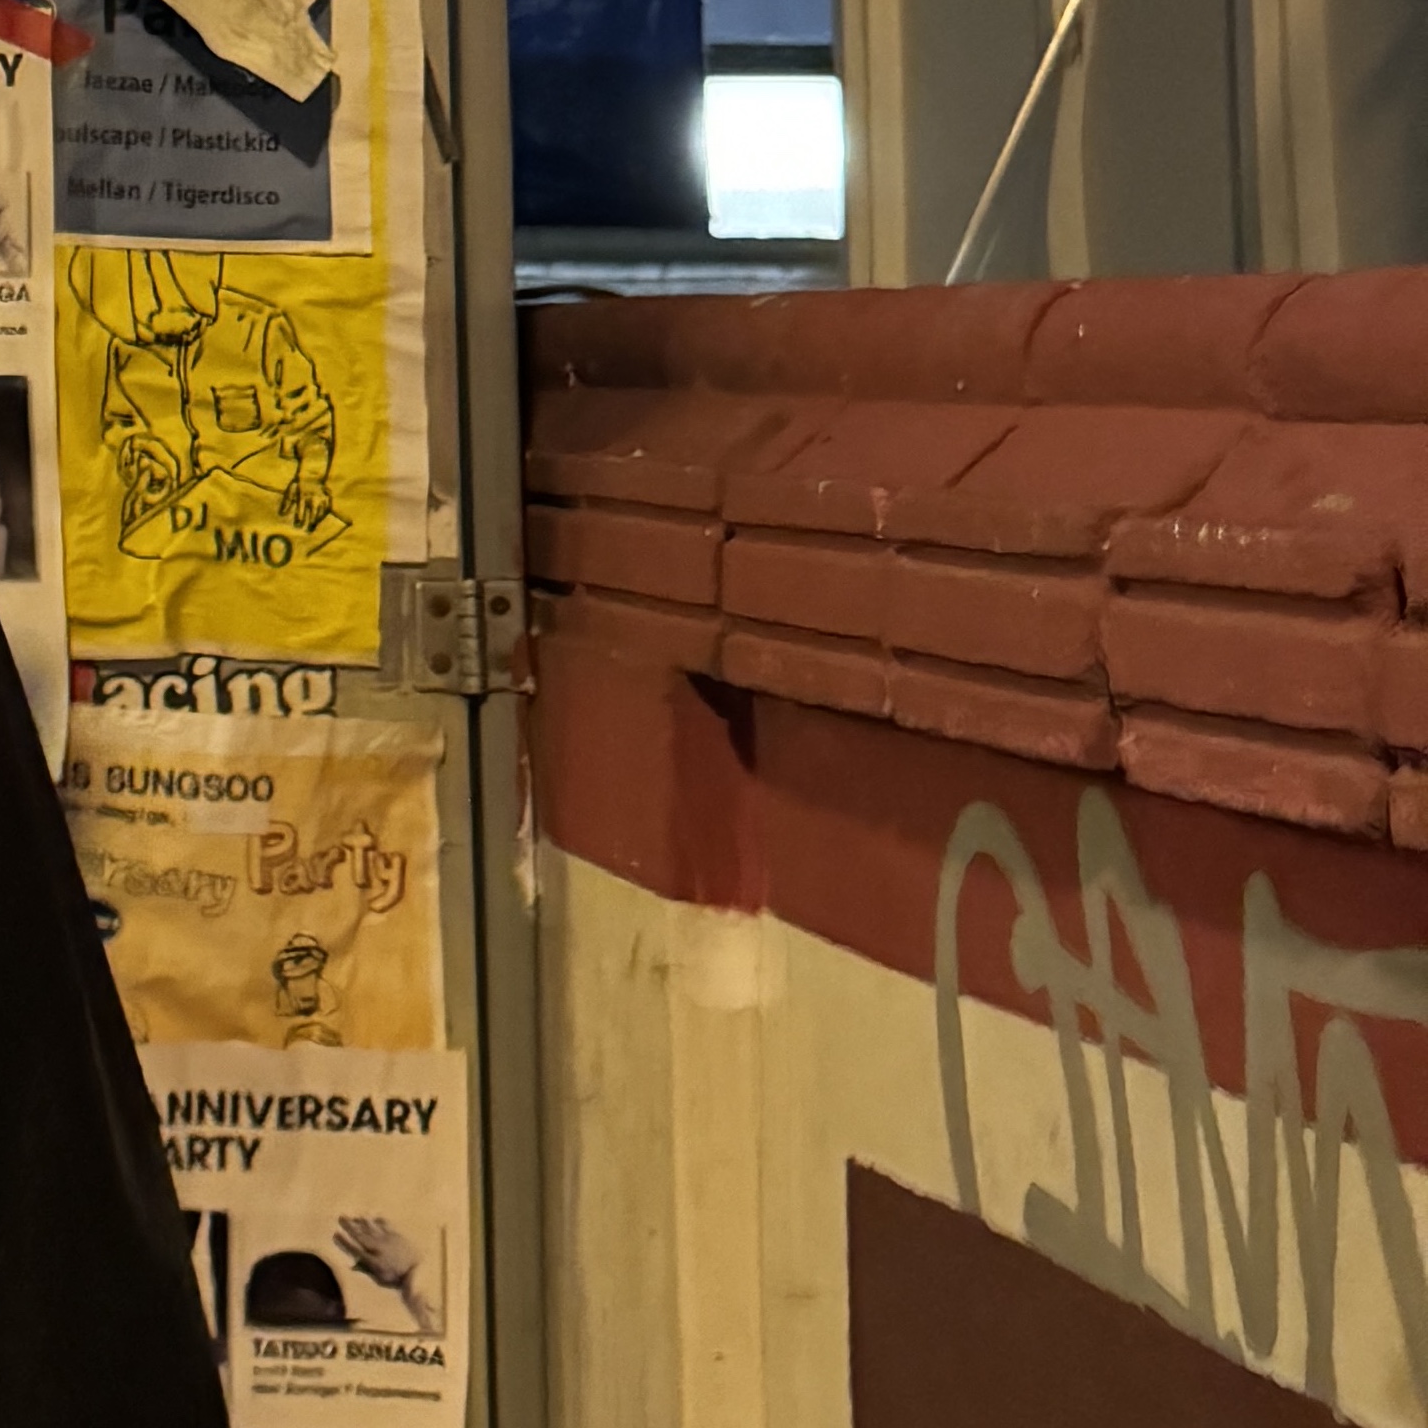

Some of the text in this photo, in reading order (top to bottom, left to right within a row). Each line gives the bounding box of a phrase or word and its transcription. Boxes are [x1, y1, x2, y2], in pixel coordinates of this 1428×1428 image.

[162, 180, 280, 210] Tigerdisco
[168, 502, 208, 534] DJ
[213, 526, 294, 569] MIO
[247, 818, 406, 914] Party
[151, 1088, 439, 1136] NNIVERSARY
